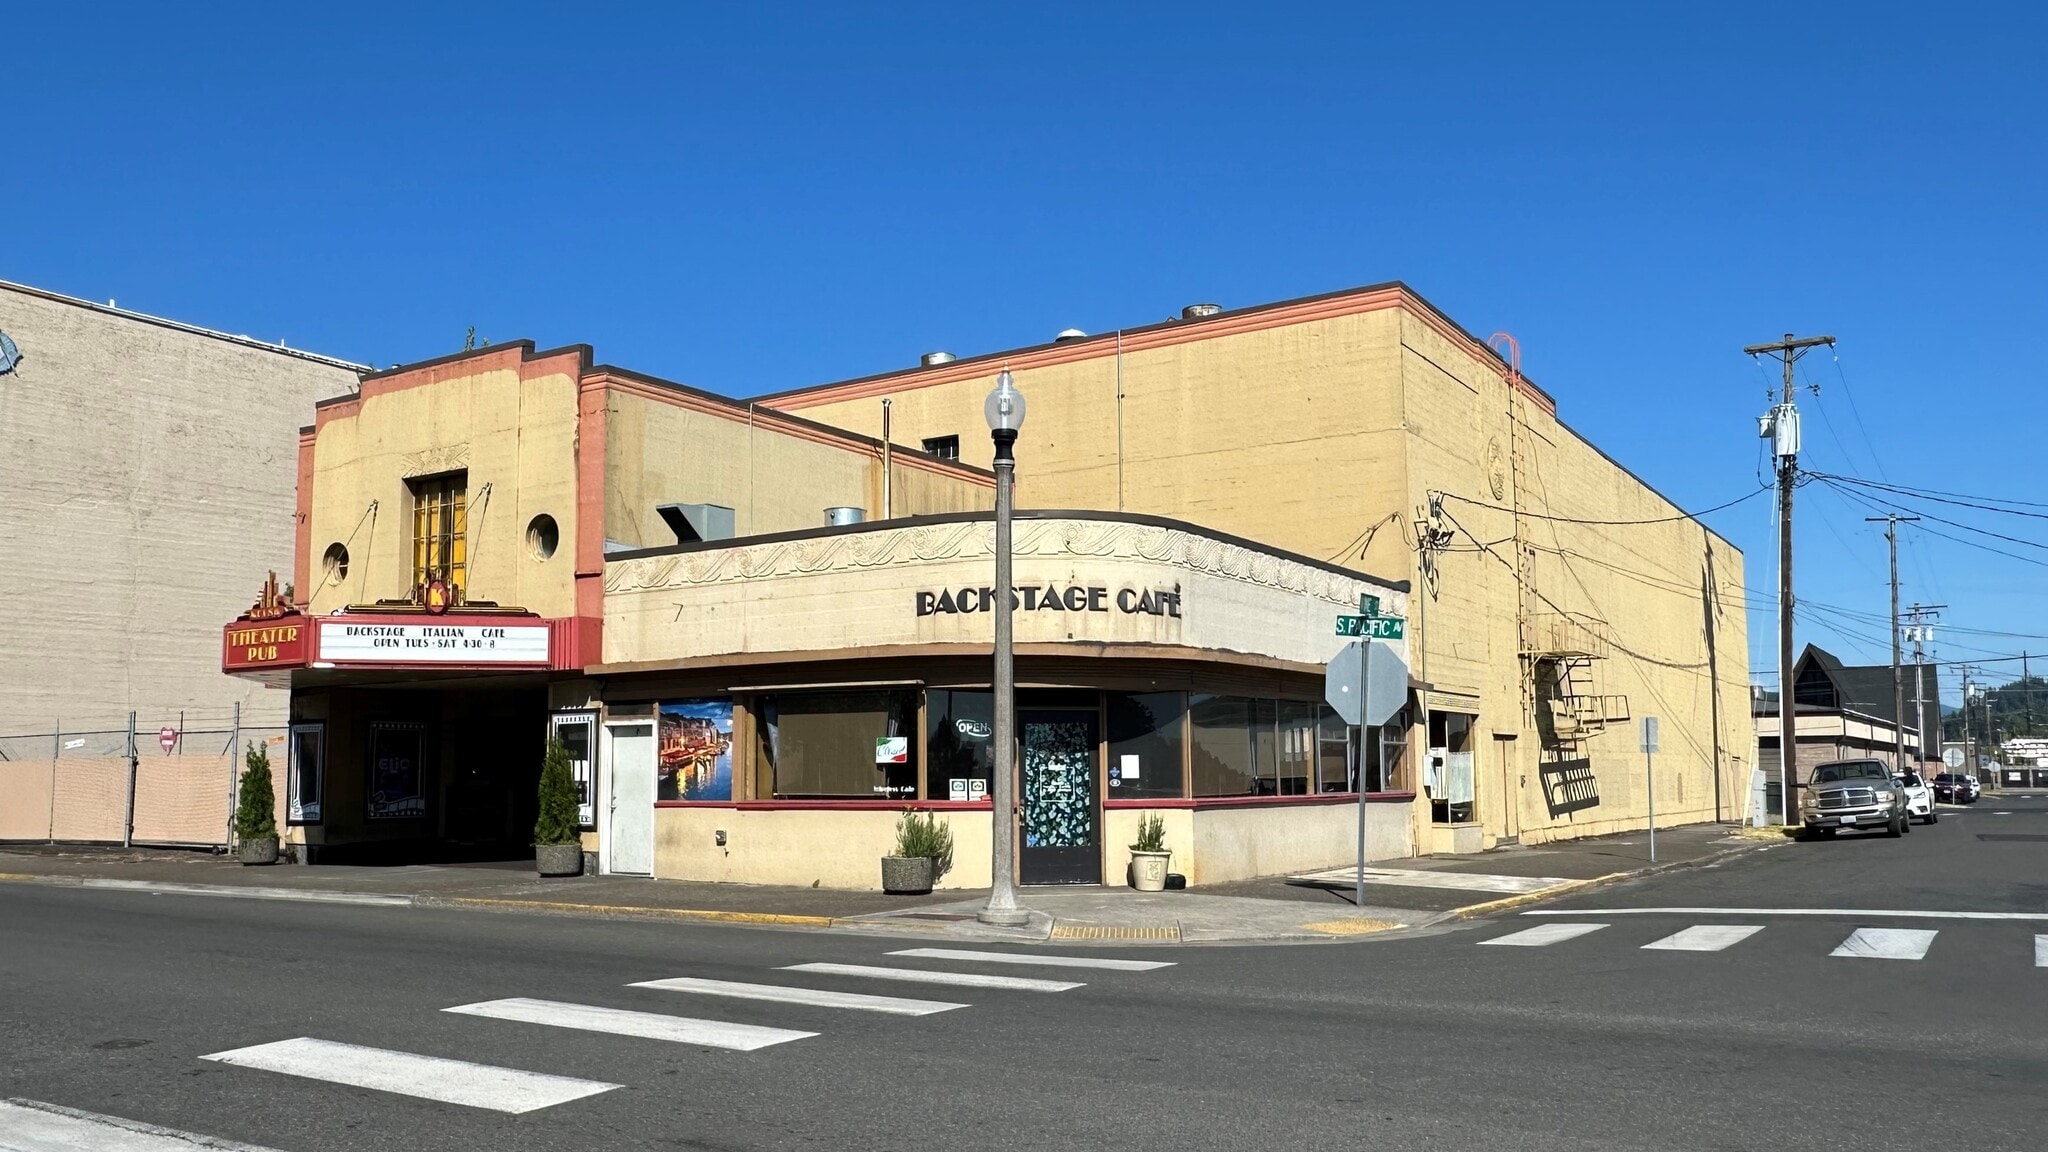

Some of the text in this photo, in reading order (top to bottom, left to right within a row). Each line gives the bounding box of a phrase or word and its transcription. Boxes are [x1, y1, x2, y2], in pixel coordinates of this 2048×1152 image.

[346, 626, 405, 636] BACKSTAGE
[423, 627, 465, 637] ITALIAN
[1348, 618, 1390, 636] PACIFIC
[231, 627, 297, 647] THEATER
[373, 638, 400, 648] OPEN
[248, 645, 278, 662] PUB
[958, 722, 988, 733] OPEN
